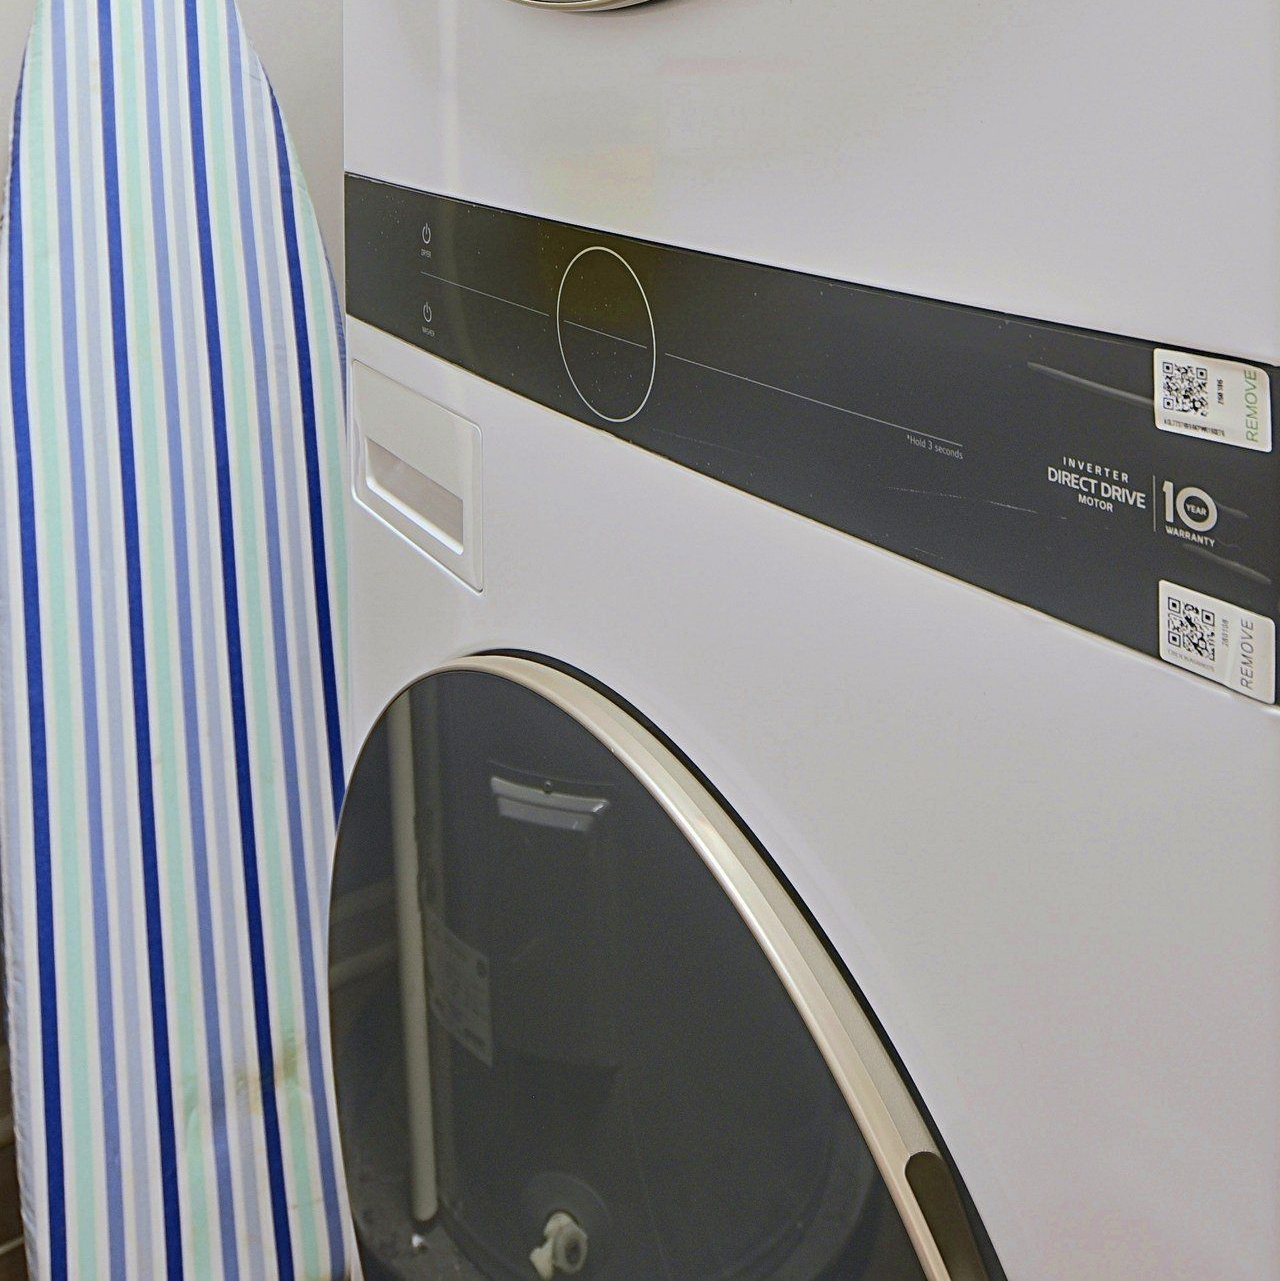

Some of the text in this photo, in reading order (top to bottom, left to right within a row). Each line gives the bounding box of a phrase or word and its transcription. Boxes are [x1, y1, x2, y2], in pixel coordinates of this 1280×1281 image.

[1244, 370, 1258, 442] REMOVE
[928, 440, 933, 450] 3
[934, 444, 963, 459] seconds
[1063, 456, 1128, 484] INVERTER
[1047, 466, 1146, 509] DIRECT DRIVE
[1078, 493, 1114, 512] MOTOR
[1162, 480, 1218, 532] 10
[1186, 503, 1207, 516] YEAR
[1165, 525, 1215, 548] WARRANTY
[1240, 618, 1254, 690] REMOVE
